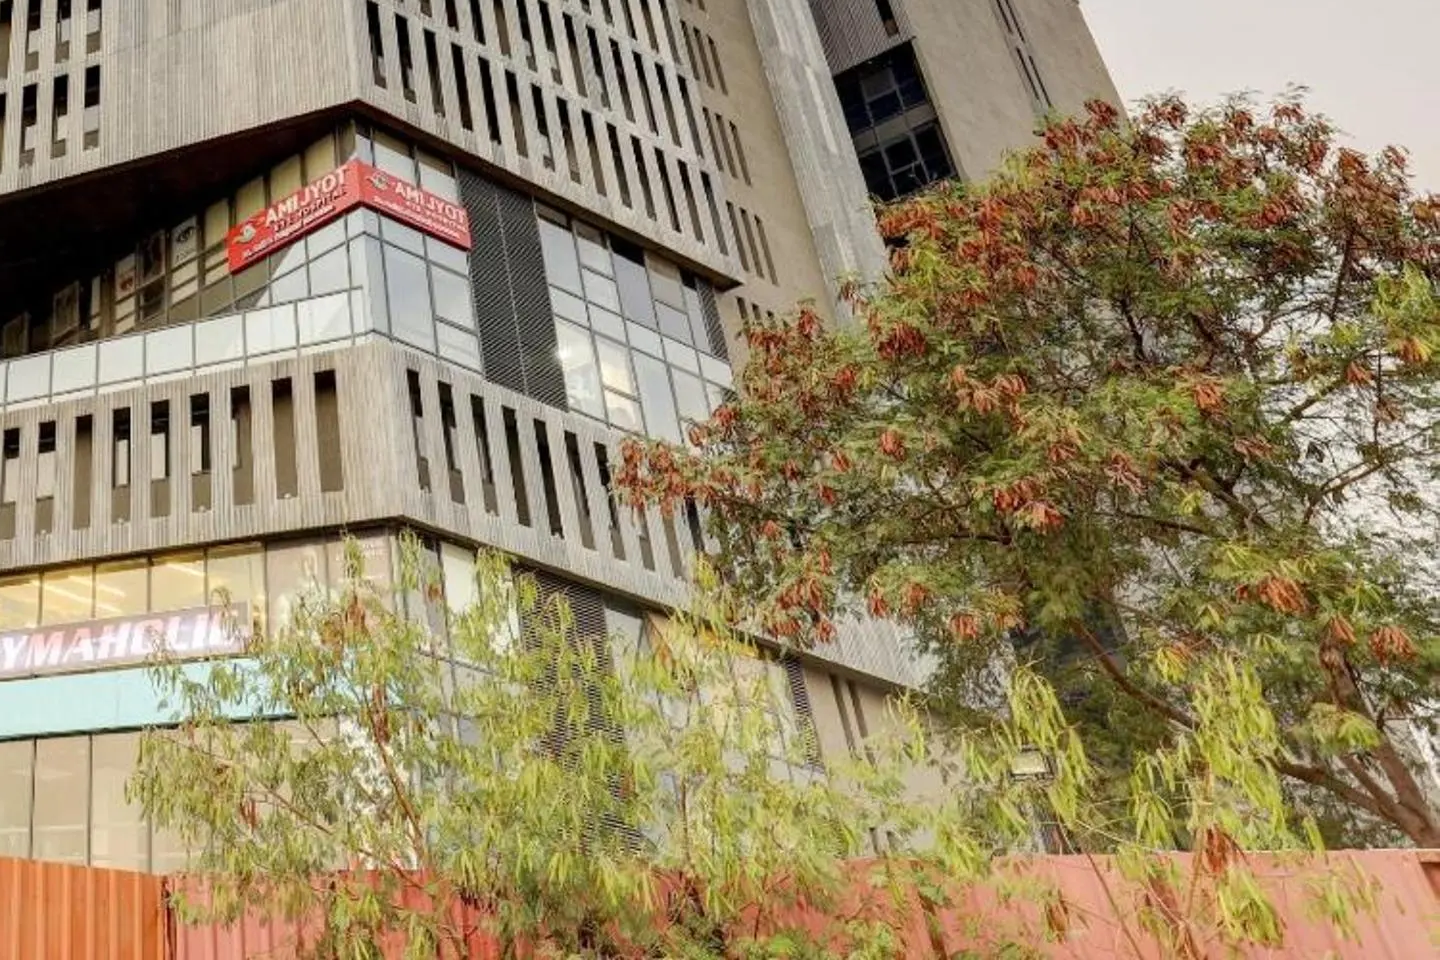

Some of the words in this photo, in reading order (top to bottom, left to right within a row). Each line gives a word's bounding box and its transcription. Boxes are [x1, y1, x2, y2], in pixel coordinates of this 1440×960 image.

[265, 195, 299, 227] AMI
[300, 165, 349, 206] JYOT
[395, 182, 425, 204] AMI
[428, 197, 466, 223] JYOT
